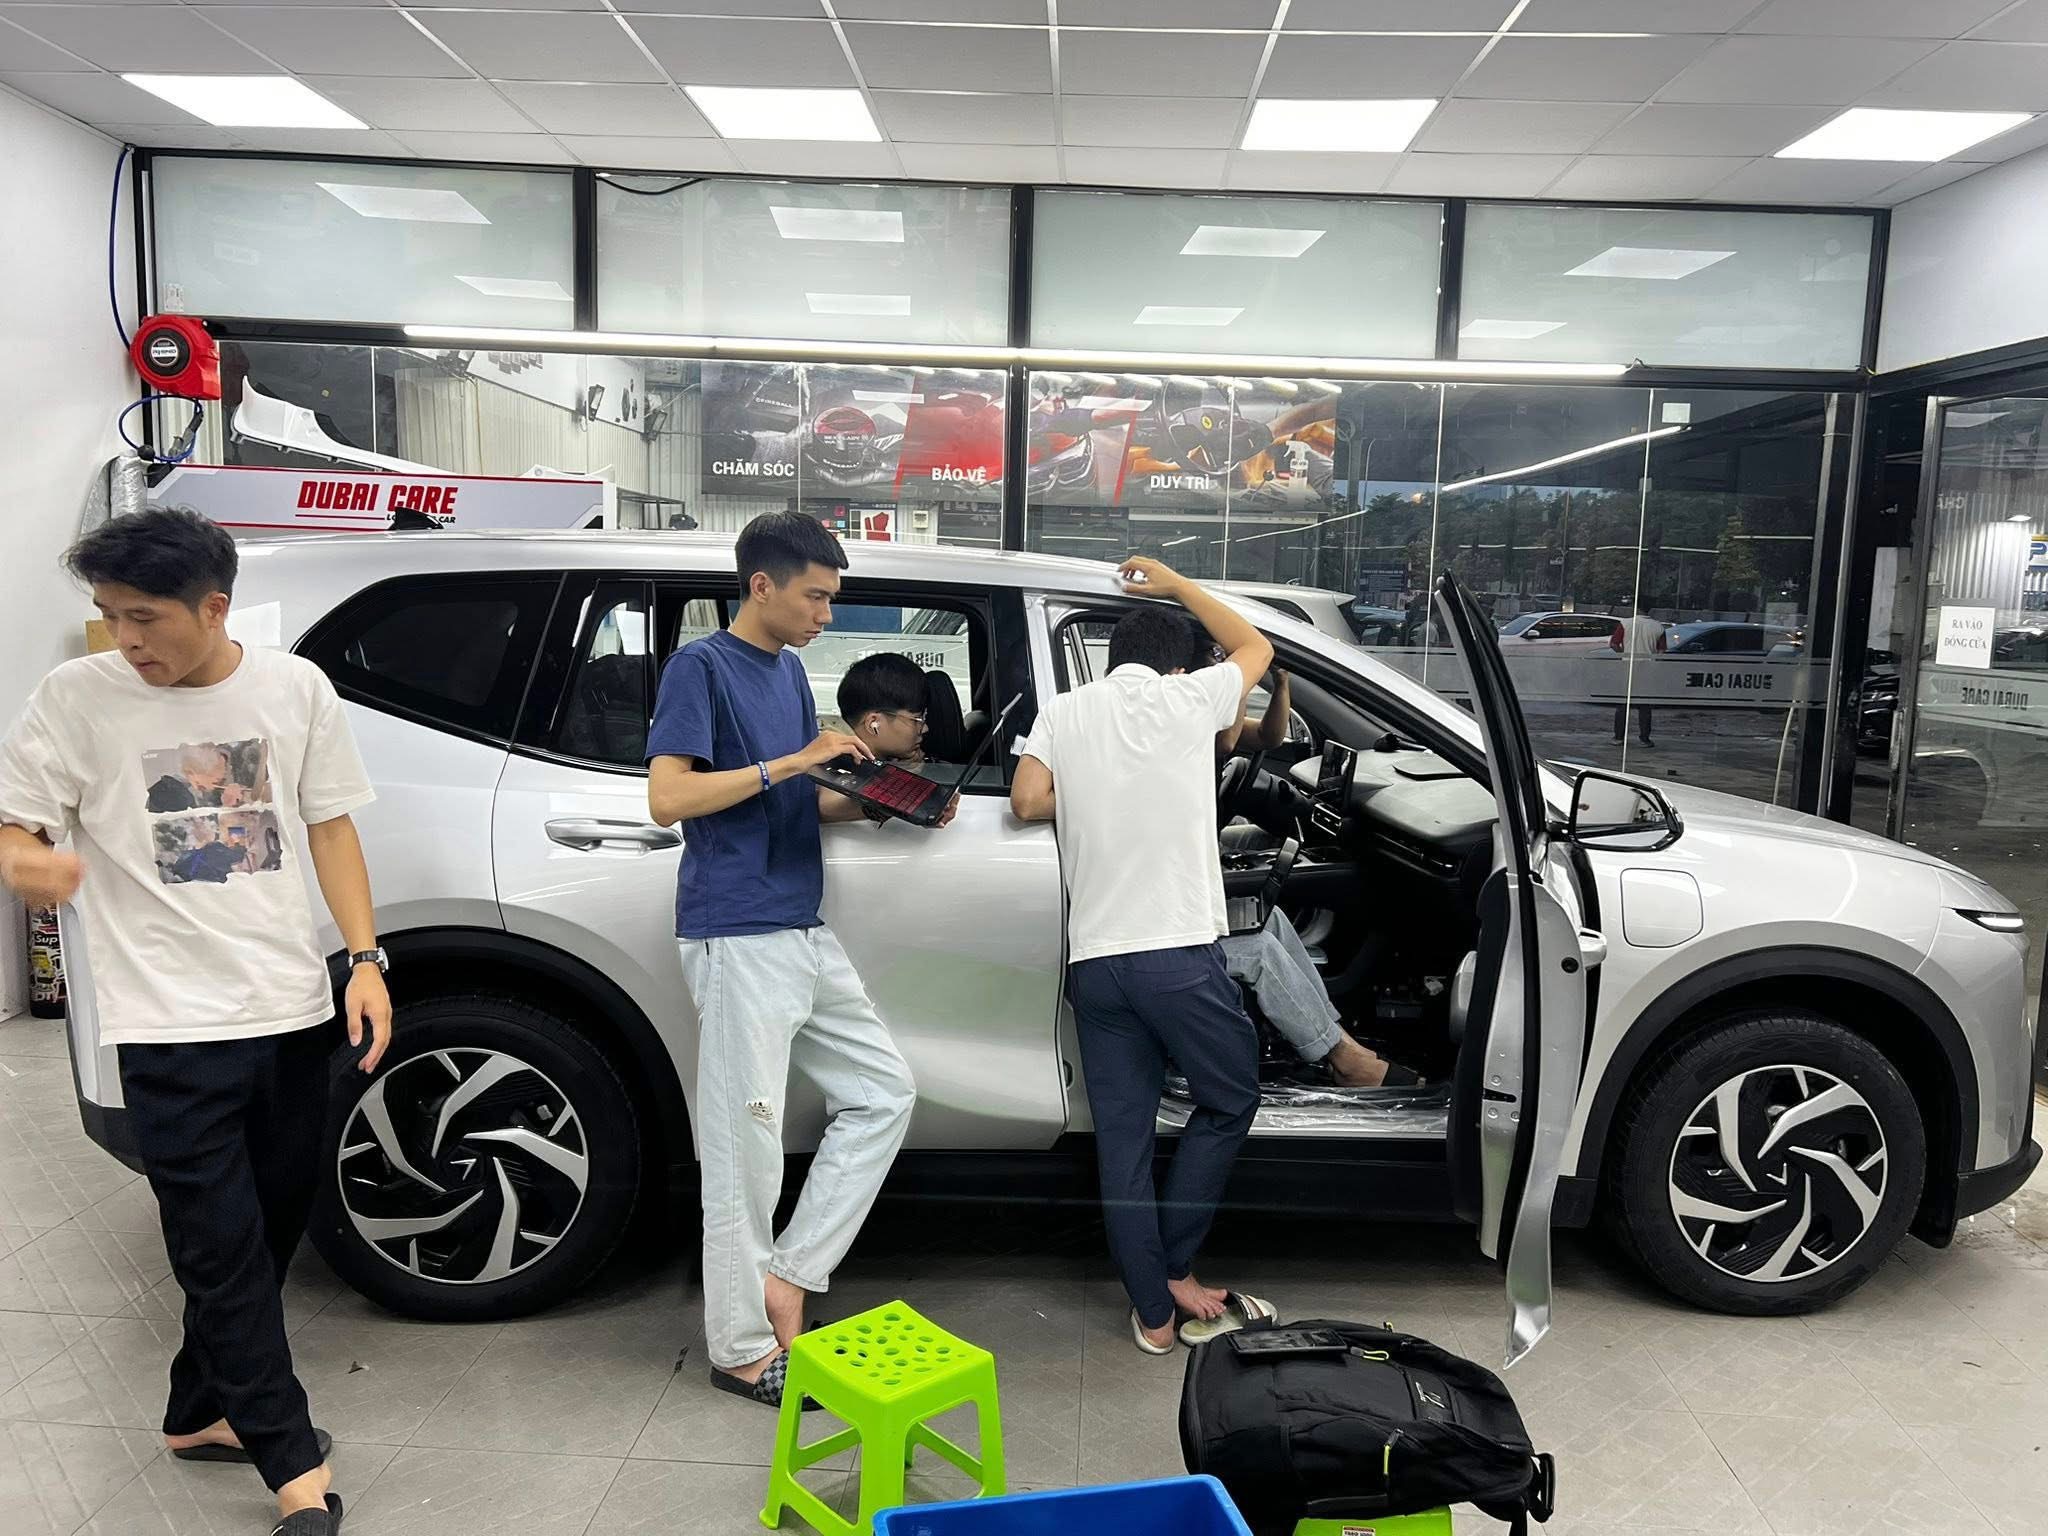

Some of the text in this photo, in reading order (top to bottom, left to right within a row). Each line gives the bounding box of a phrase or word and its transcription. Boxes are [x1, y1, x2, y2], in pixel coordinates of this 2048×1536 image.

[712, 459, 795, 477] CHĂM SÓC
[931, 464, 963, 481] BẢO
[1150, 474, 1210, 490] DUY TRÌ
[297, 481, 459, 515] DUBAI CARE
[1951, 617, 1983, 630] RA VÀO
[1968, 636, 1987, 649] CỬA
